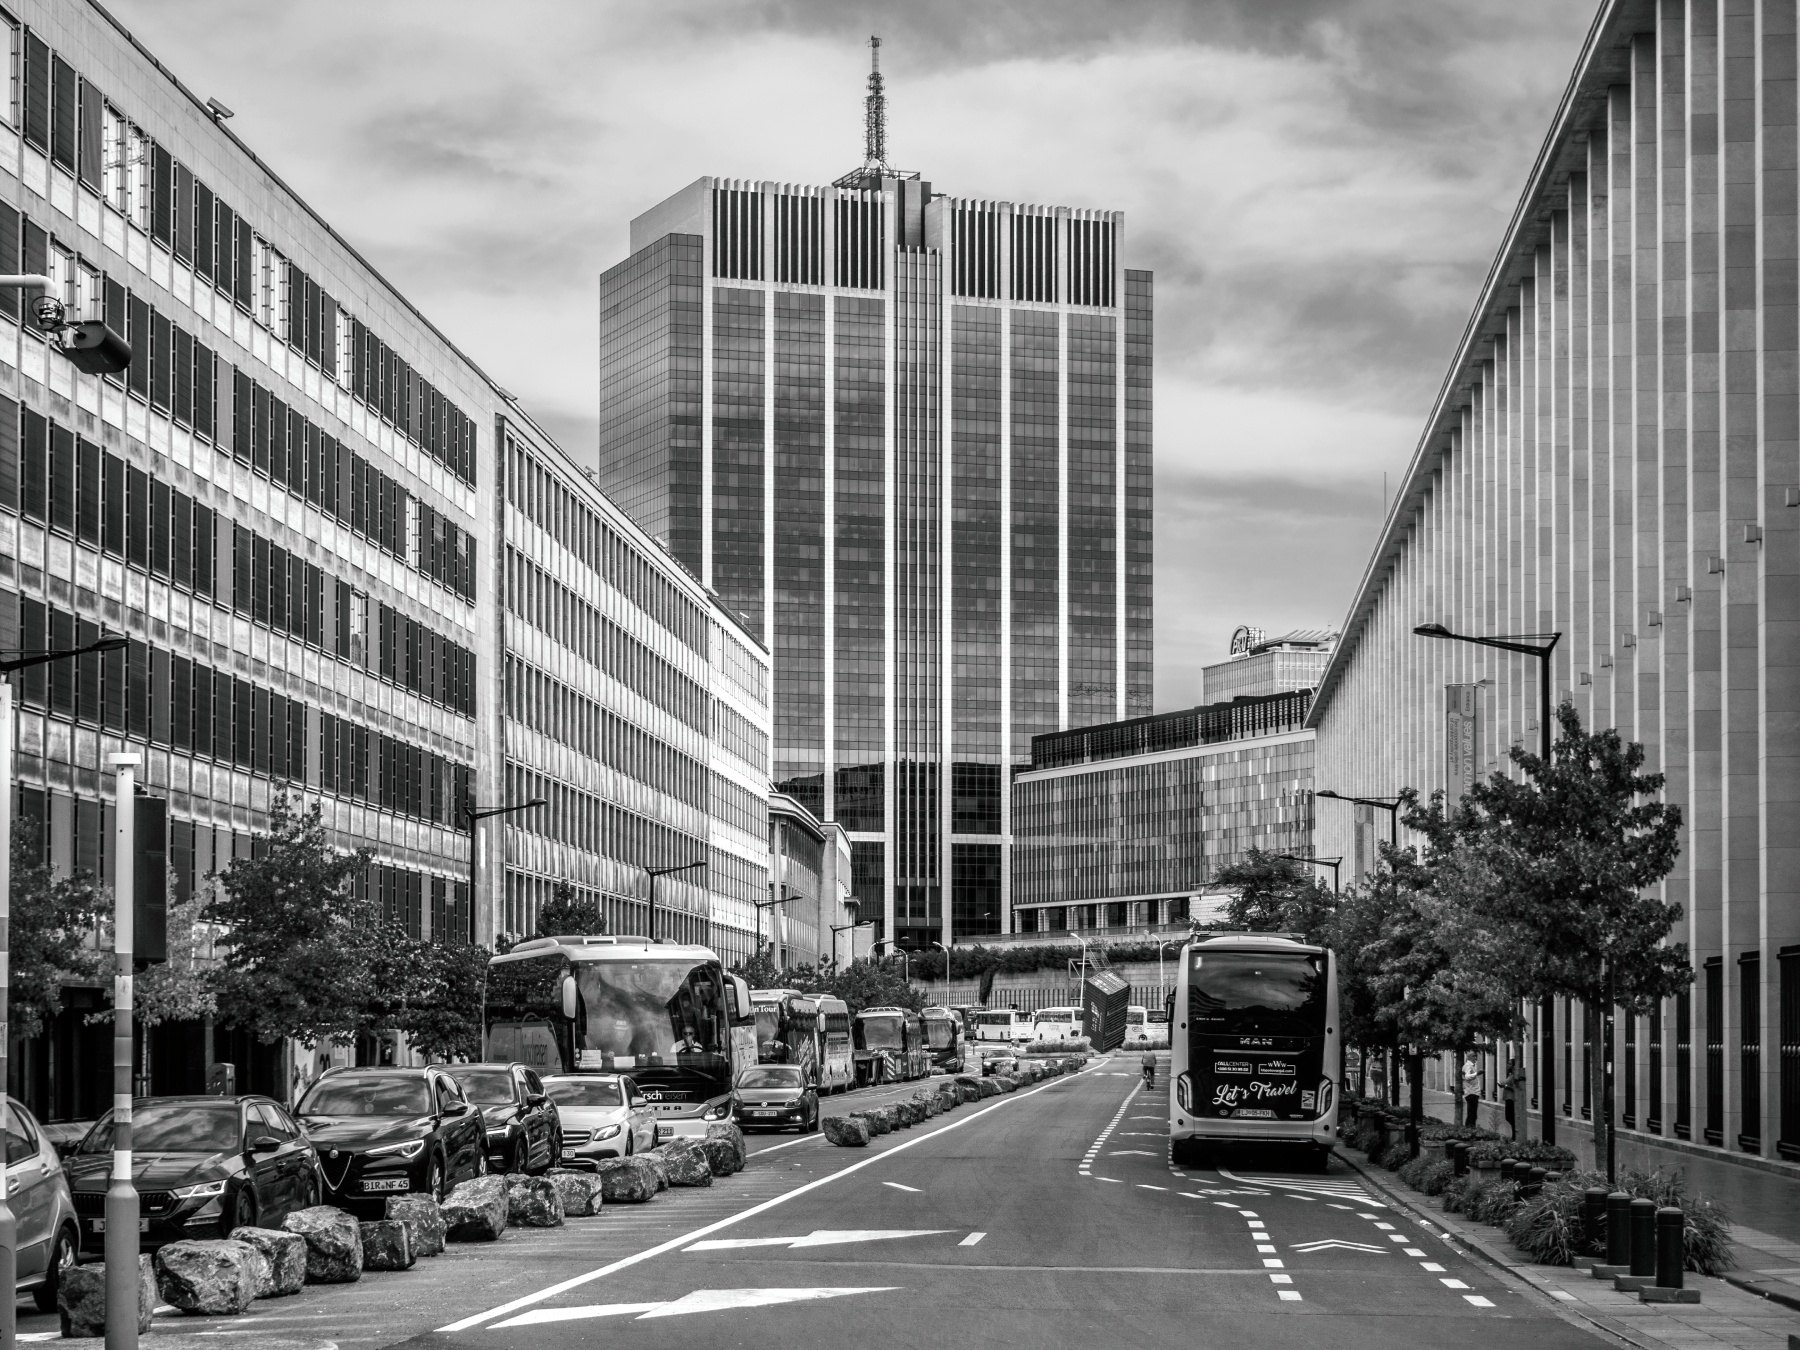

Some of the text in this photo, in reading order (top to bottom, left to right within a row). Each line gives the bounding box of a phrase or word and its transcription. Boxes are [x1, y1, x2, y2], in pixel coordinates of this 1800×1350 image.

[1462, 720, 1473, 796] mmon values
[754, 1005, 777, 1013] nTour
[1240, 1037, 1273, 1045] MAN
[1212, 1084, 1250, 1107] Let's
[1249, 1080, 1298, 1100] Travel
[364, 1179, 409, 1190] BIR NF 45
